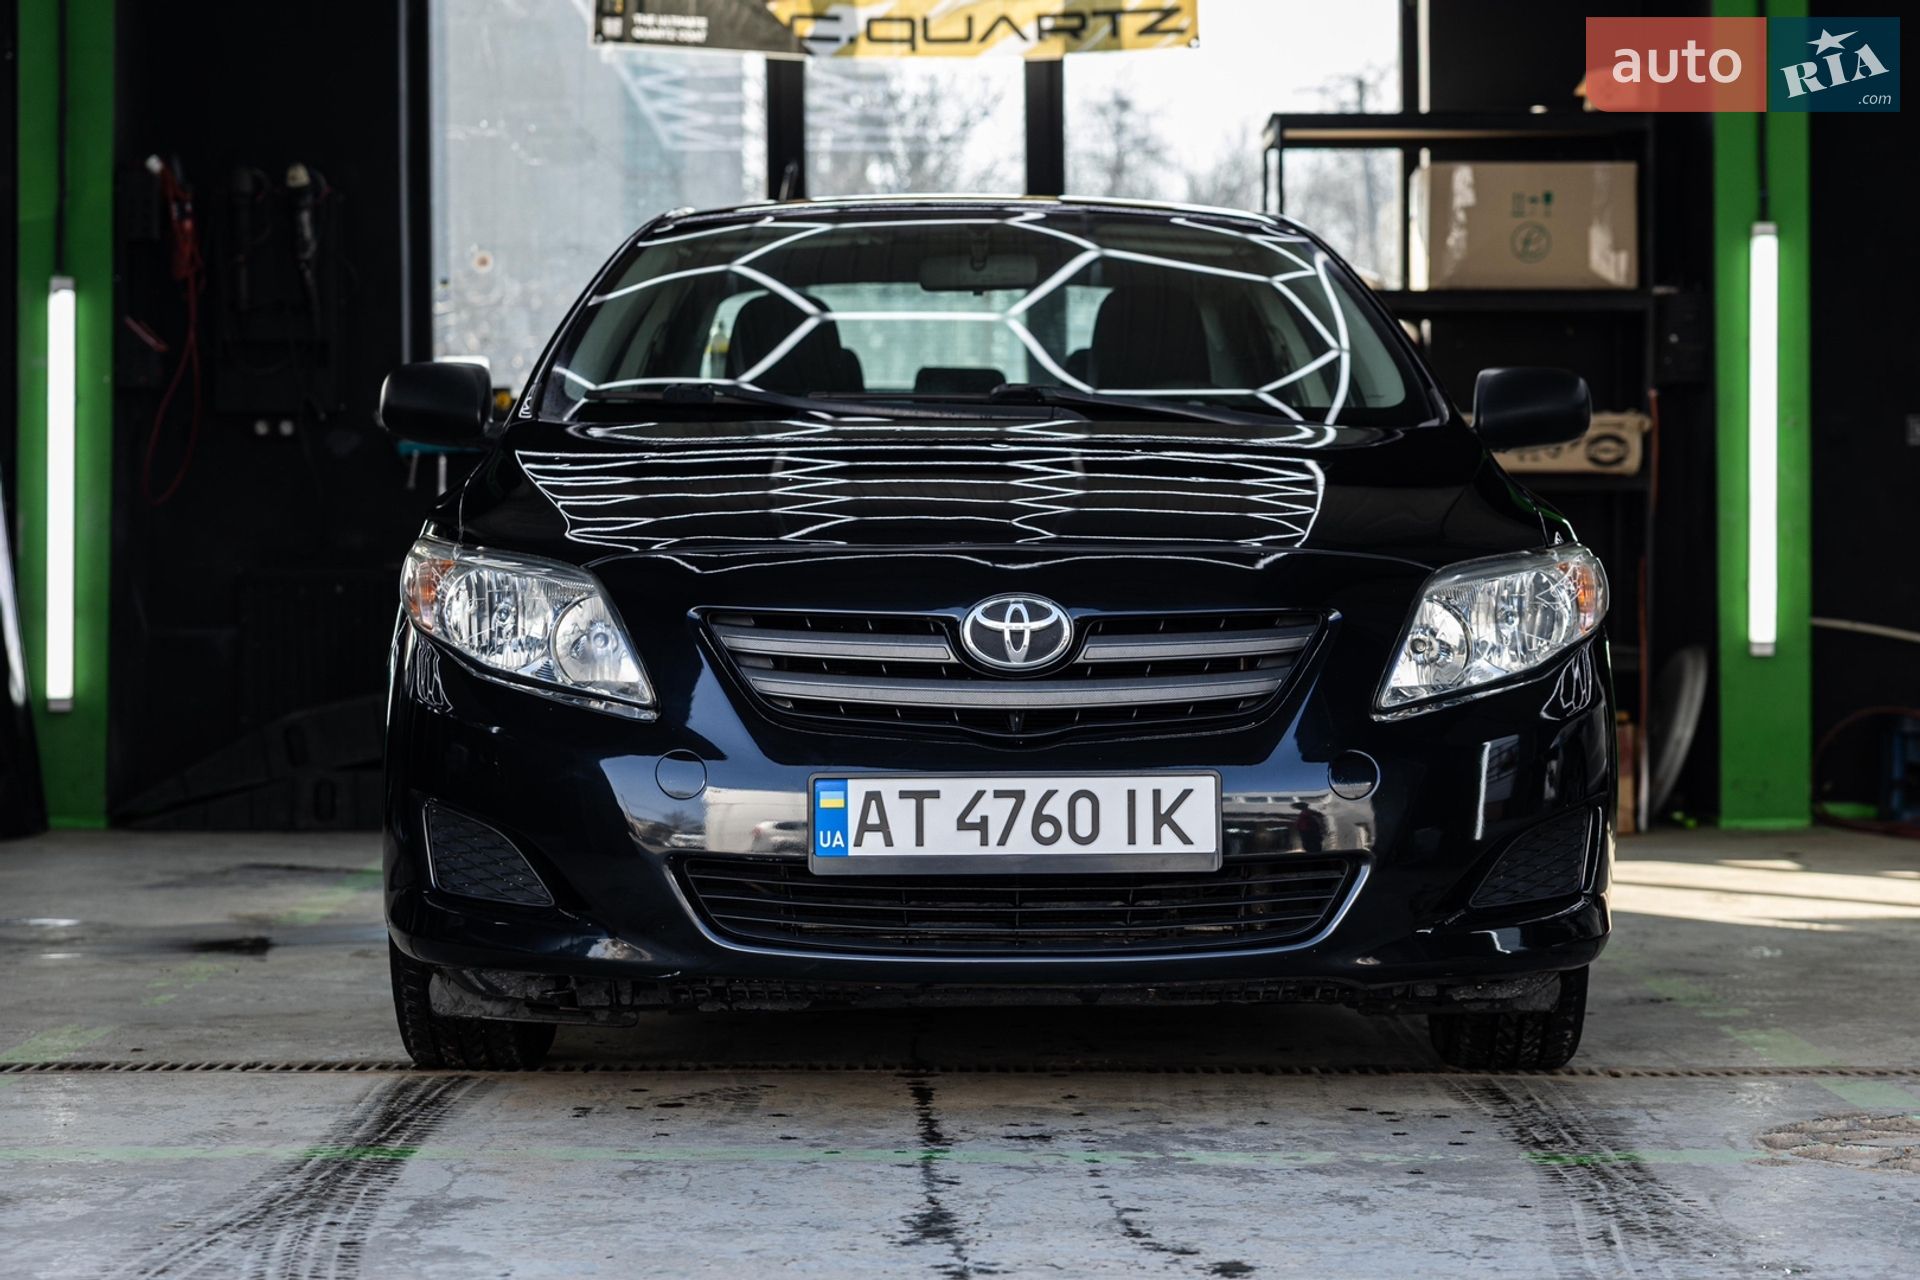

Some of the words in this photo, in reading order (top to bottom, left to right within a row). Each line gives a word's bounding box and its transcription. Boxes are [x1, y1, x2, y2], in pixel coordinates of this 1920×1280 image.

[853, 789, 941, 847] AT
[956, 788, 1100, 847] 4760
[1126, 788, 1194, 845] IK
[819, 830, 845, 848] UA
